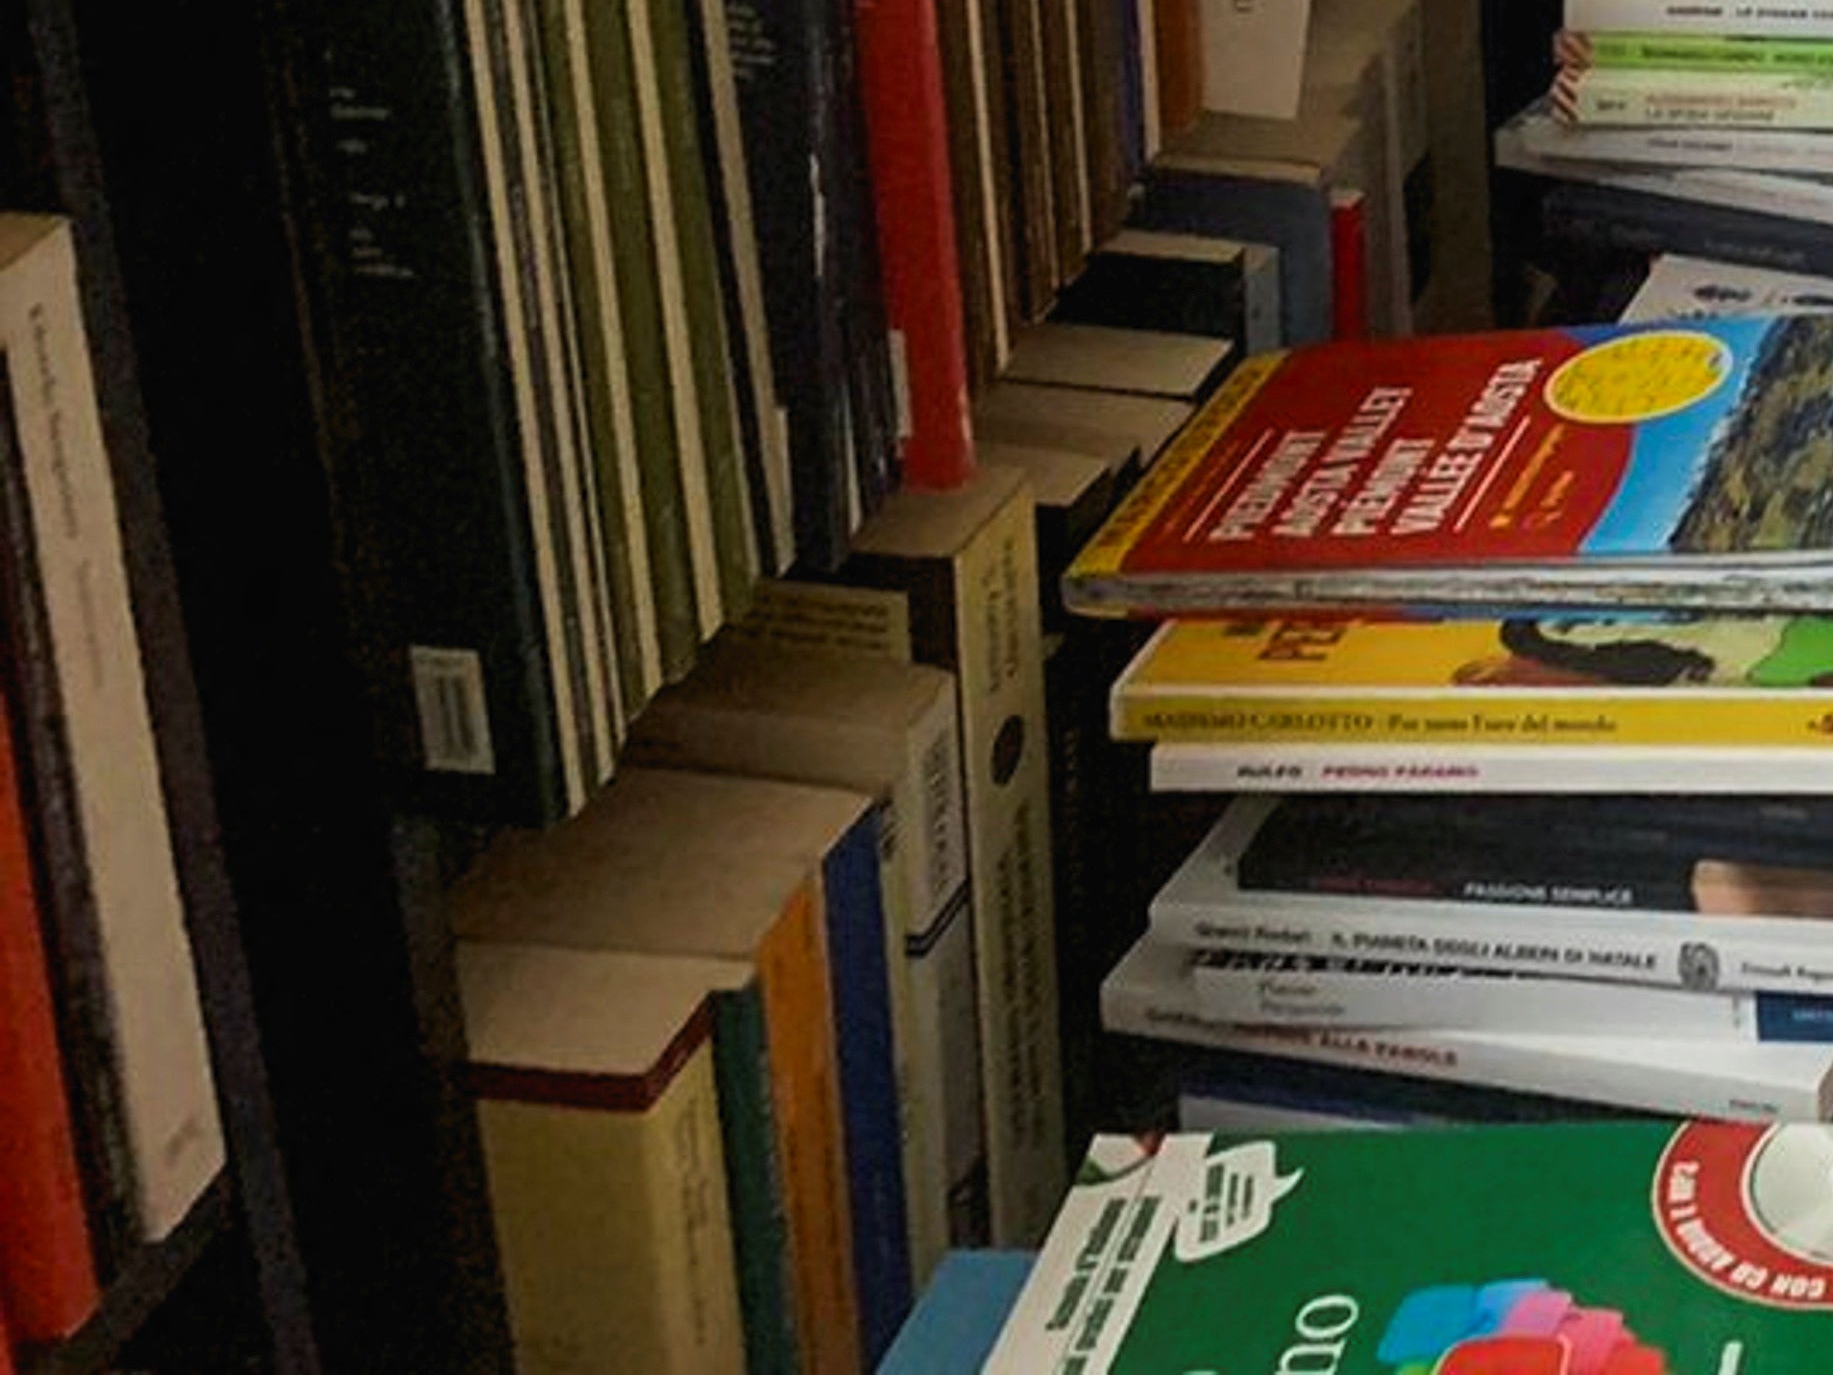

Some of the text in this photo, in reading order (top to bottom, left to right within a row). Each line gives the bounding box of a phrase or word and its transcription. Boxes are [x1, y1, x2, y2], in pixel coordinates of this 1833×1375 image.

[1463, 881, 1546, 902] PASSIONE
[1551, 884, 1634, 905] SEMPLICE
[1586, 951, 1657, 970] NATALE
[1730, 1260, 1769, 1292] CD
[1770, 1273, 1828, 1300] CON
